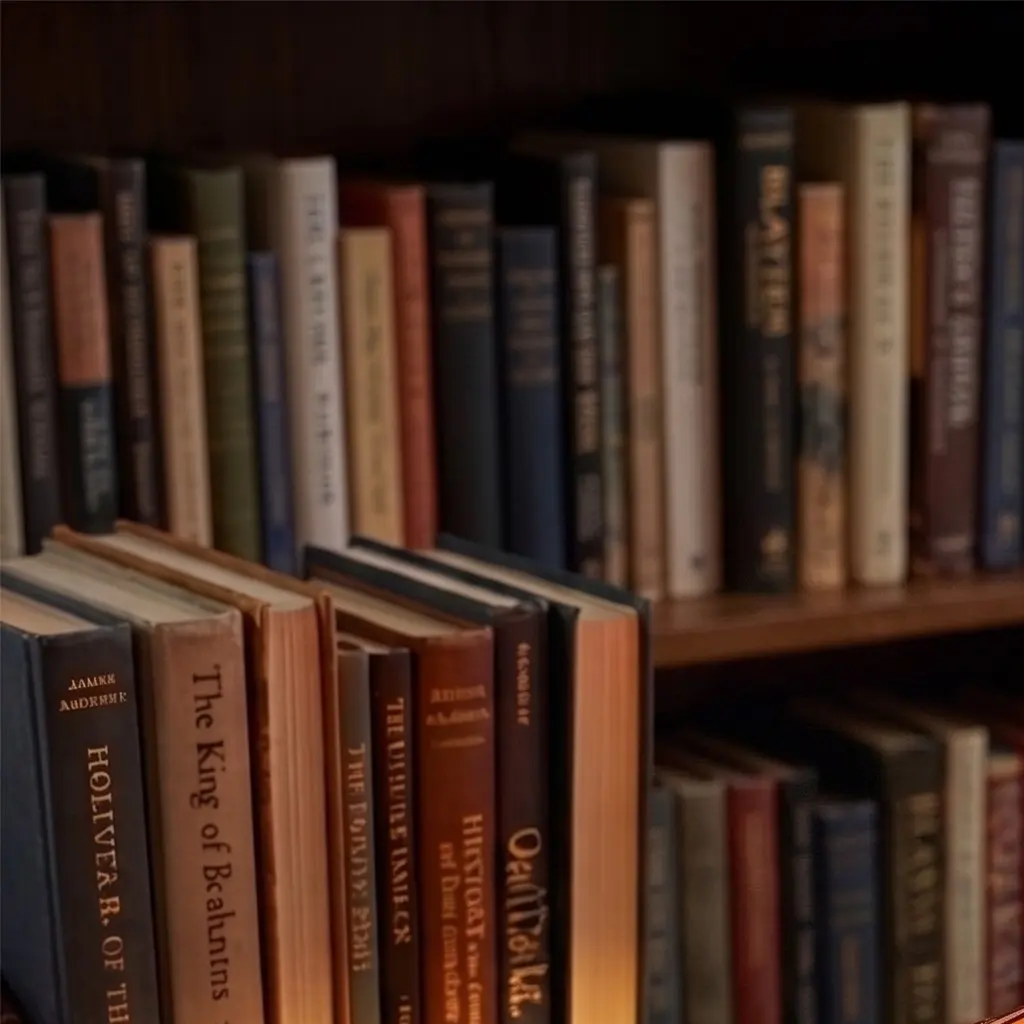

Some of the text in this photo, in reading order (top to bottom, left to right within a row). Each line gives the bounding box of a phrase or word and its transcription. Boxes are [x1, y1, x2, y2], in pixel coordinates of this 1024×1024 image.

[193, 664, 224, 729] The
[190, 740, 226, 809] King
[201, 823, 231, 855] of
[102, 935, 124, 971] OF
